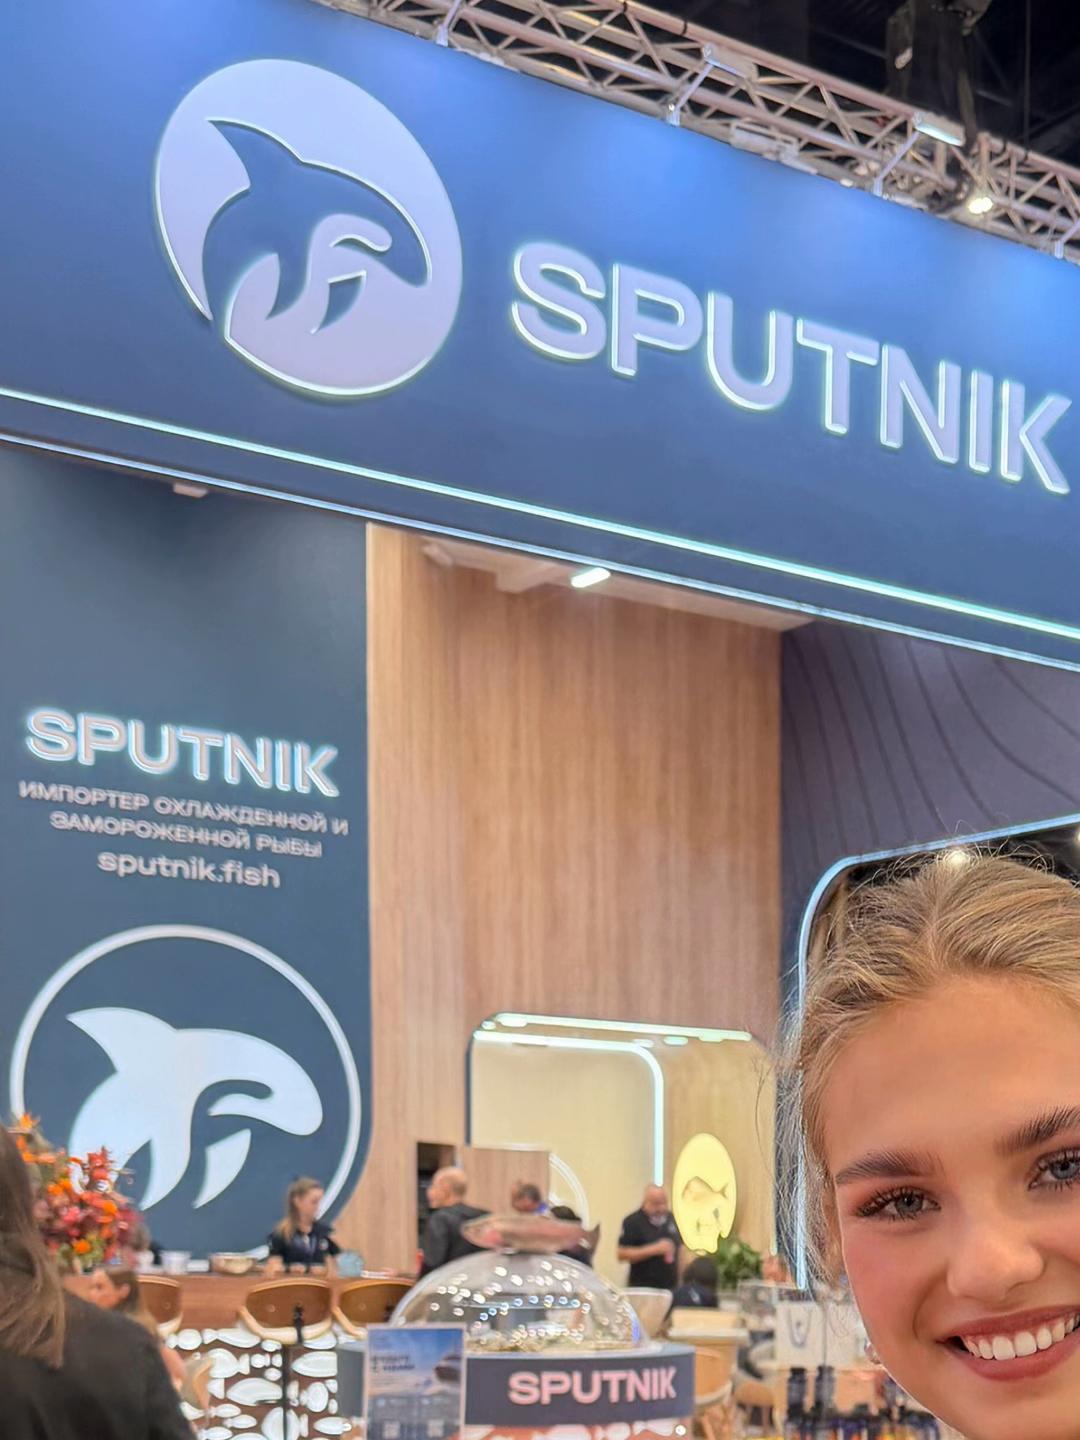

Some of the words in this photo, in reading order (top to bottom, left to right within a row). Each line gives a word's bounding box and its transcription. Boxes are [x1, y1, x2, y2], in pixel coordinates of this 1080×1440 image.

[511, 241, 1072, 494] SPUTNIK
[25, 708, 339, 797] SPUTNIK
[18, 780, 150, 811] ИМПОРТЕР
[153, 796, 327, 834] ОХЛАЖДЕННОЙ
[331, 816, 349, 836] И
[50, 810, 250, 850] ЗАМОРОЖЕННОЙ
[255, 833, 323, 859] РЫБЫ
[97, 851, 281, 888] sputnik.fish
[508, 1366, 677, 1405] SPUTNIK
